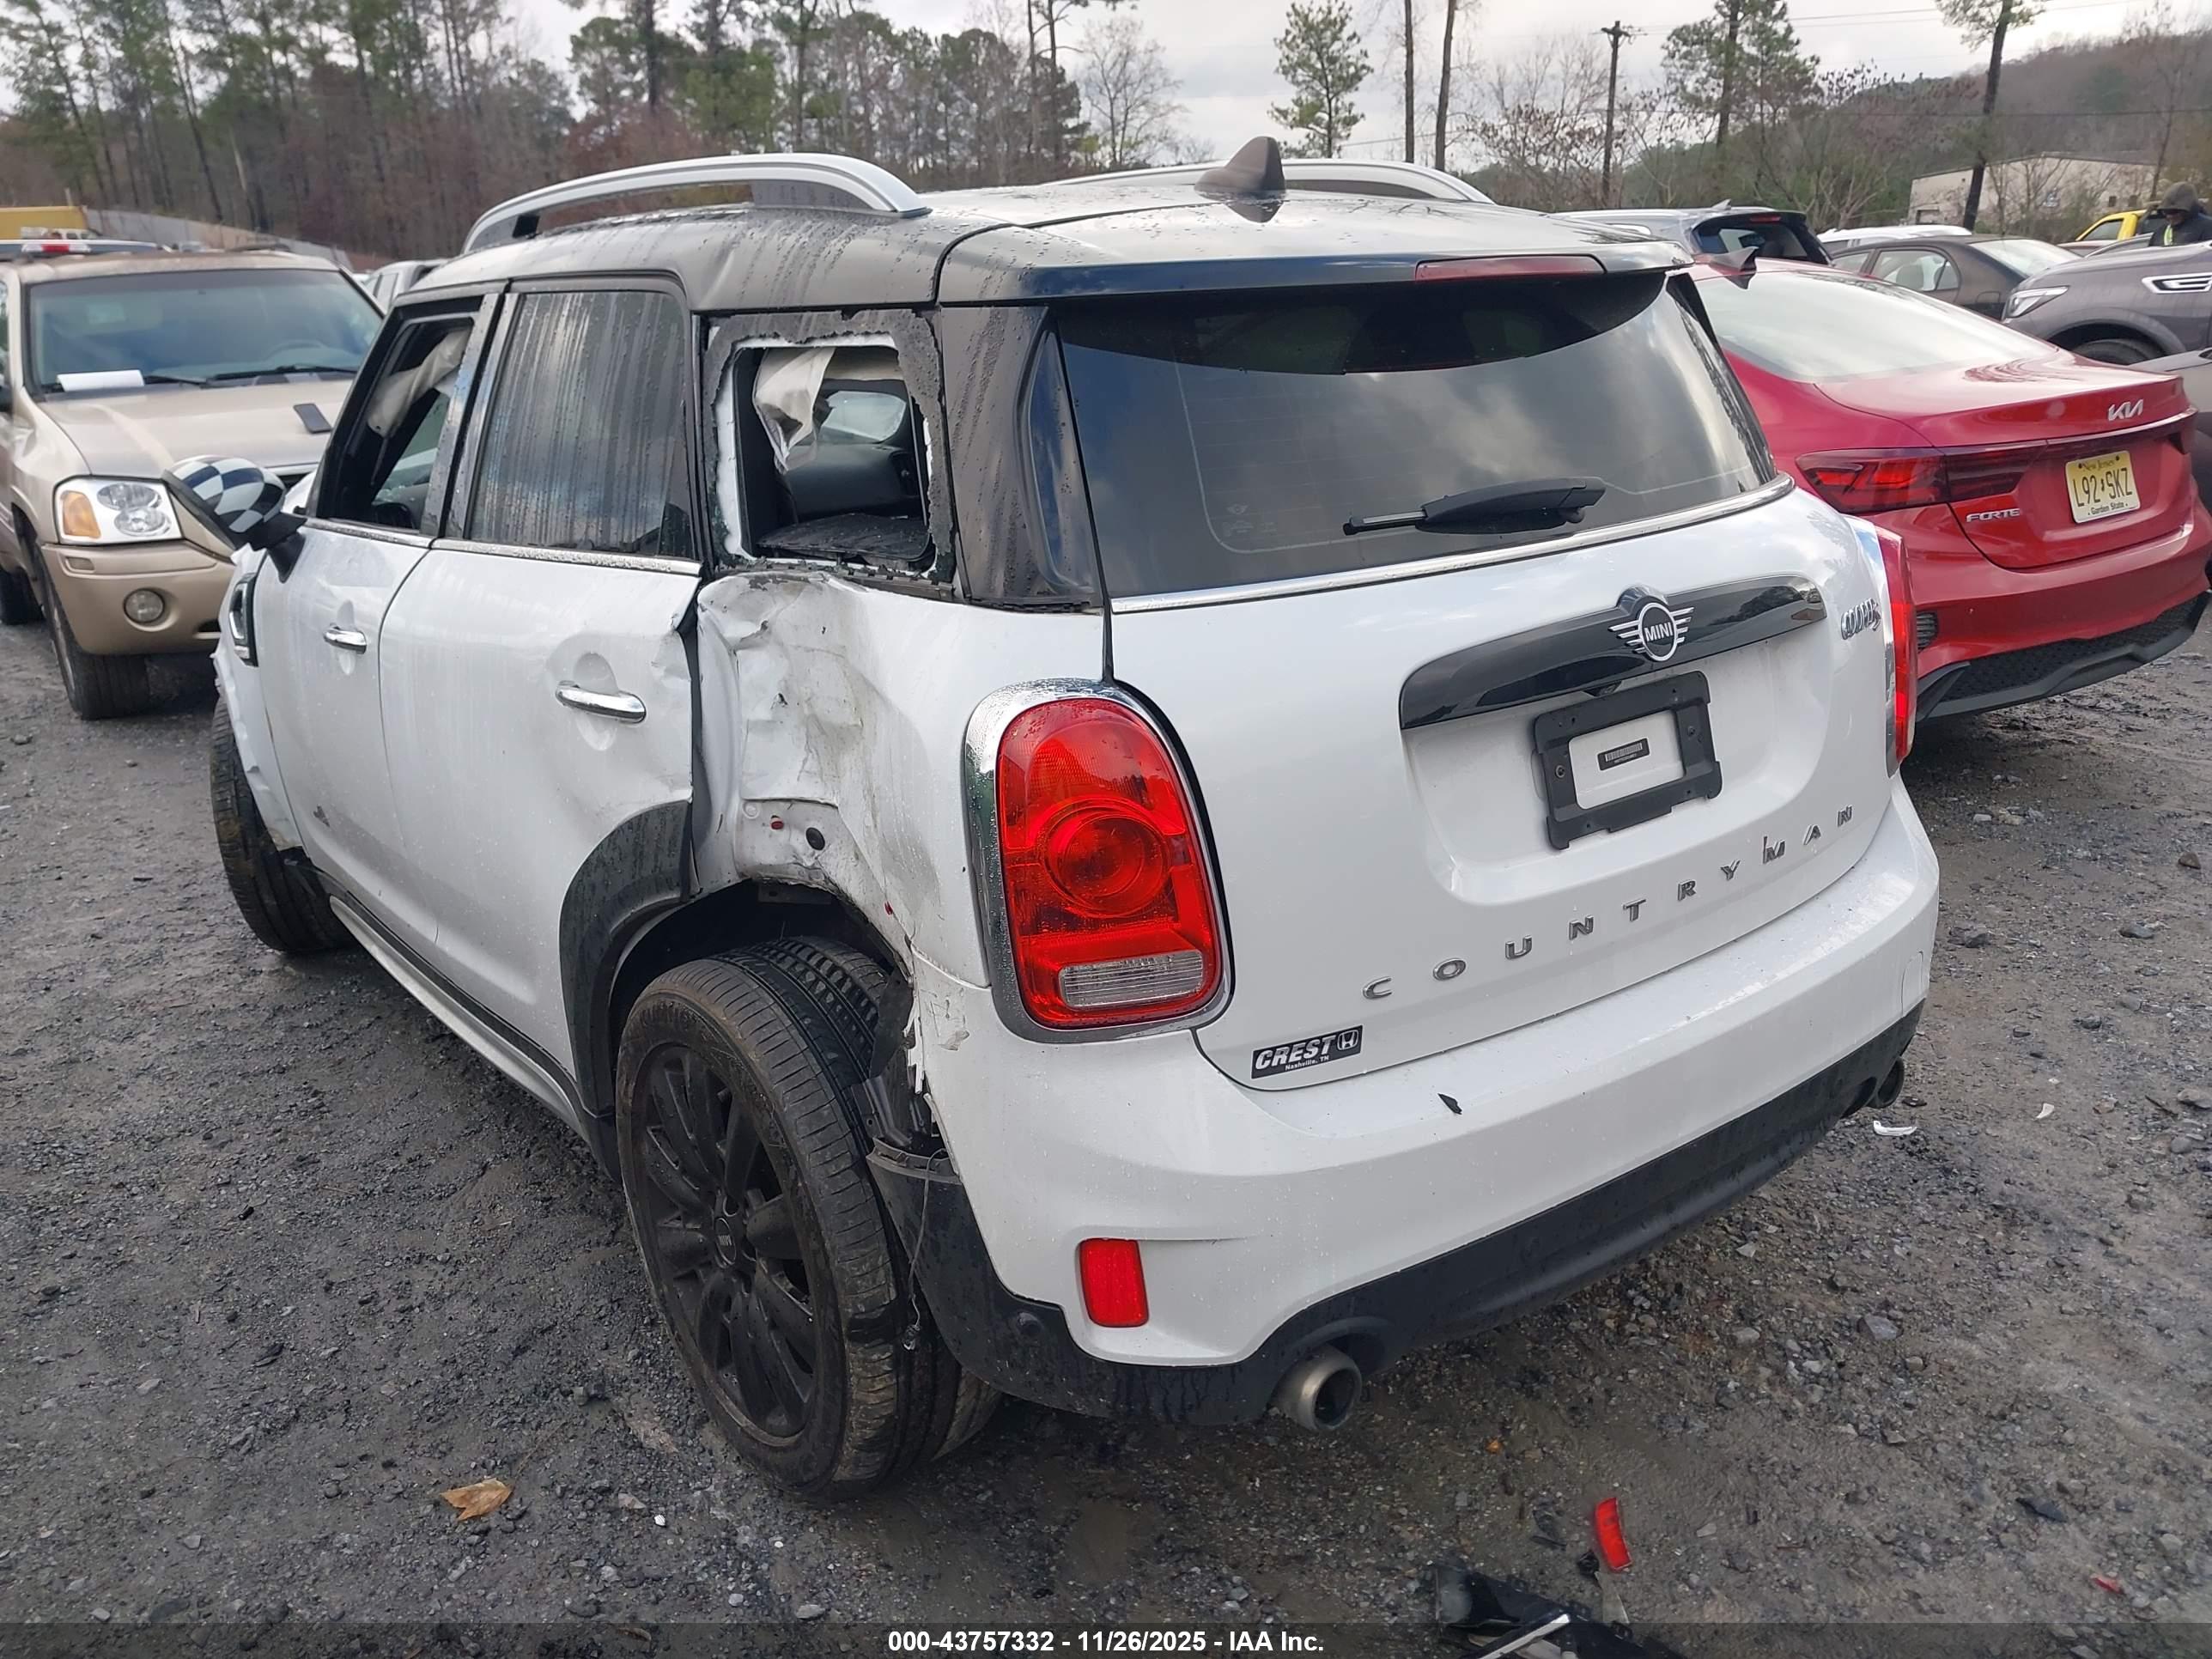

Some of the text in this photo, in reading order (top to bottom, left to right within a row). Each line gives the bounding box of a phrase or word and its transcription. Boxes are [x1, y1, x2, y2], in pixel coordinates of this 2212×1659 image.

[1966, 508, 2021, 523] FORTE
[1644, 621, 1674, 641] MINI
[1362, 804, 1854, 1000] COUNTRYMAN
[1255, 1035, 1336, 1070] CREST
[1320, 1054, 1329, 1063] TN
